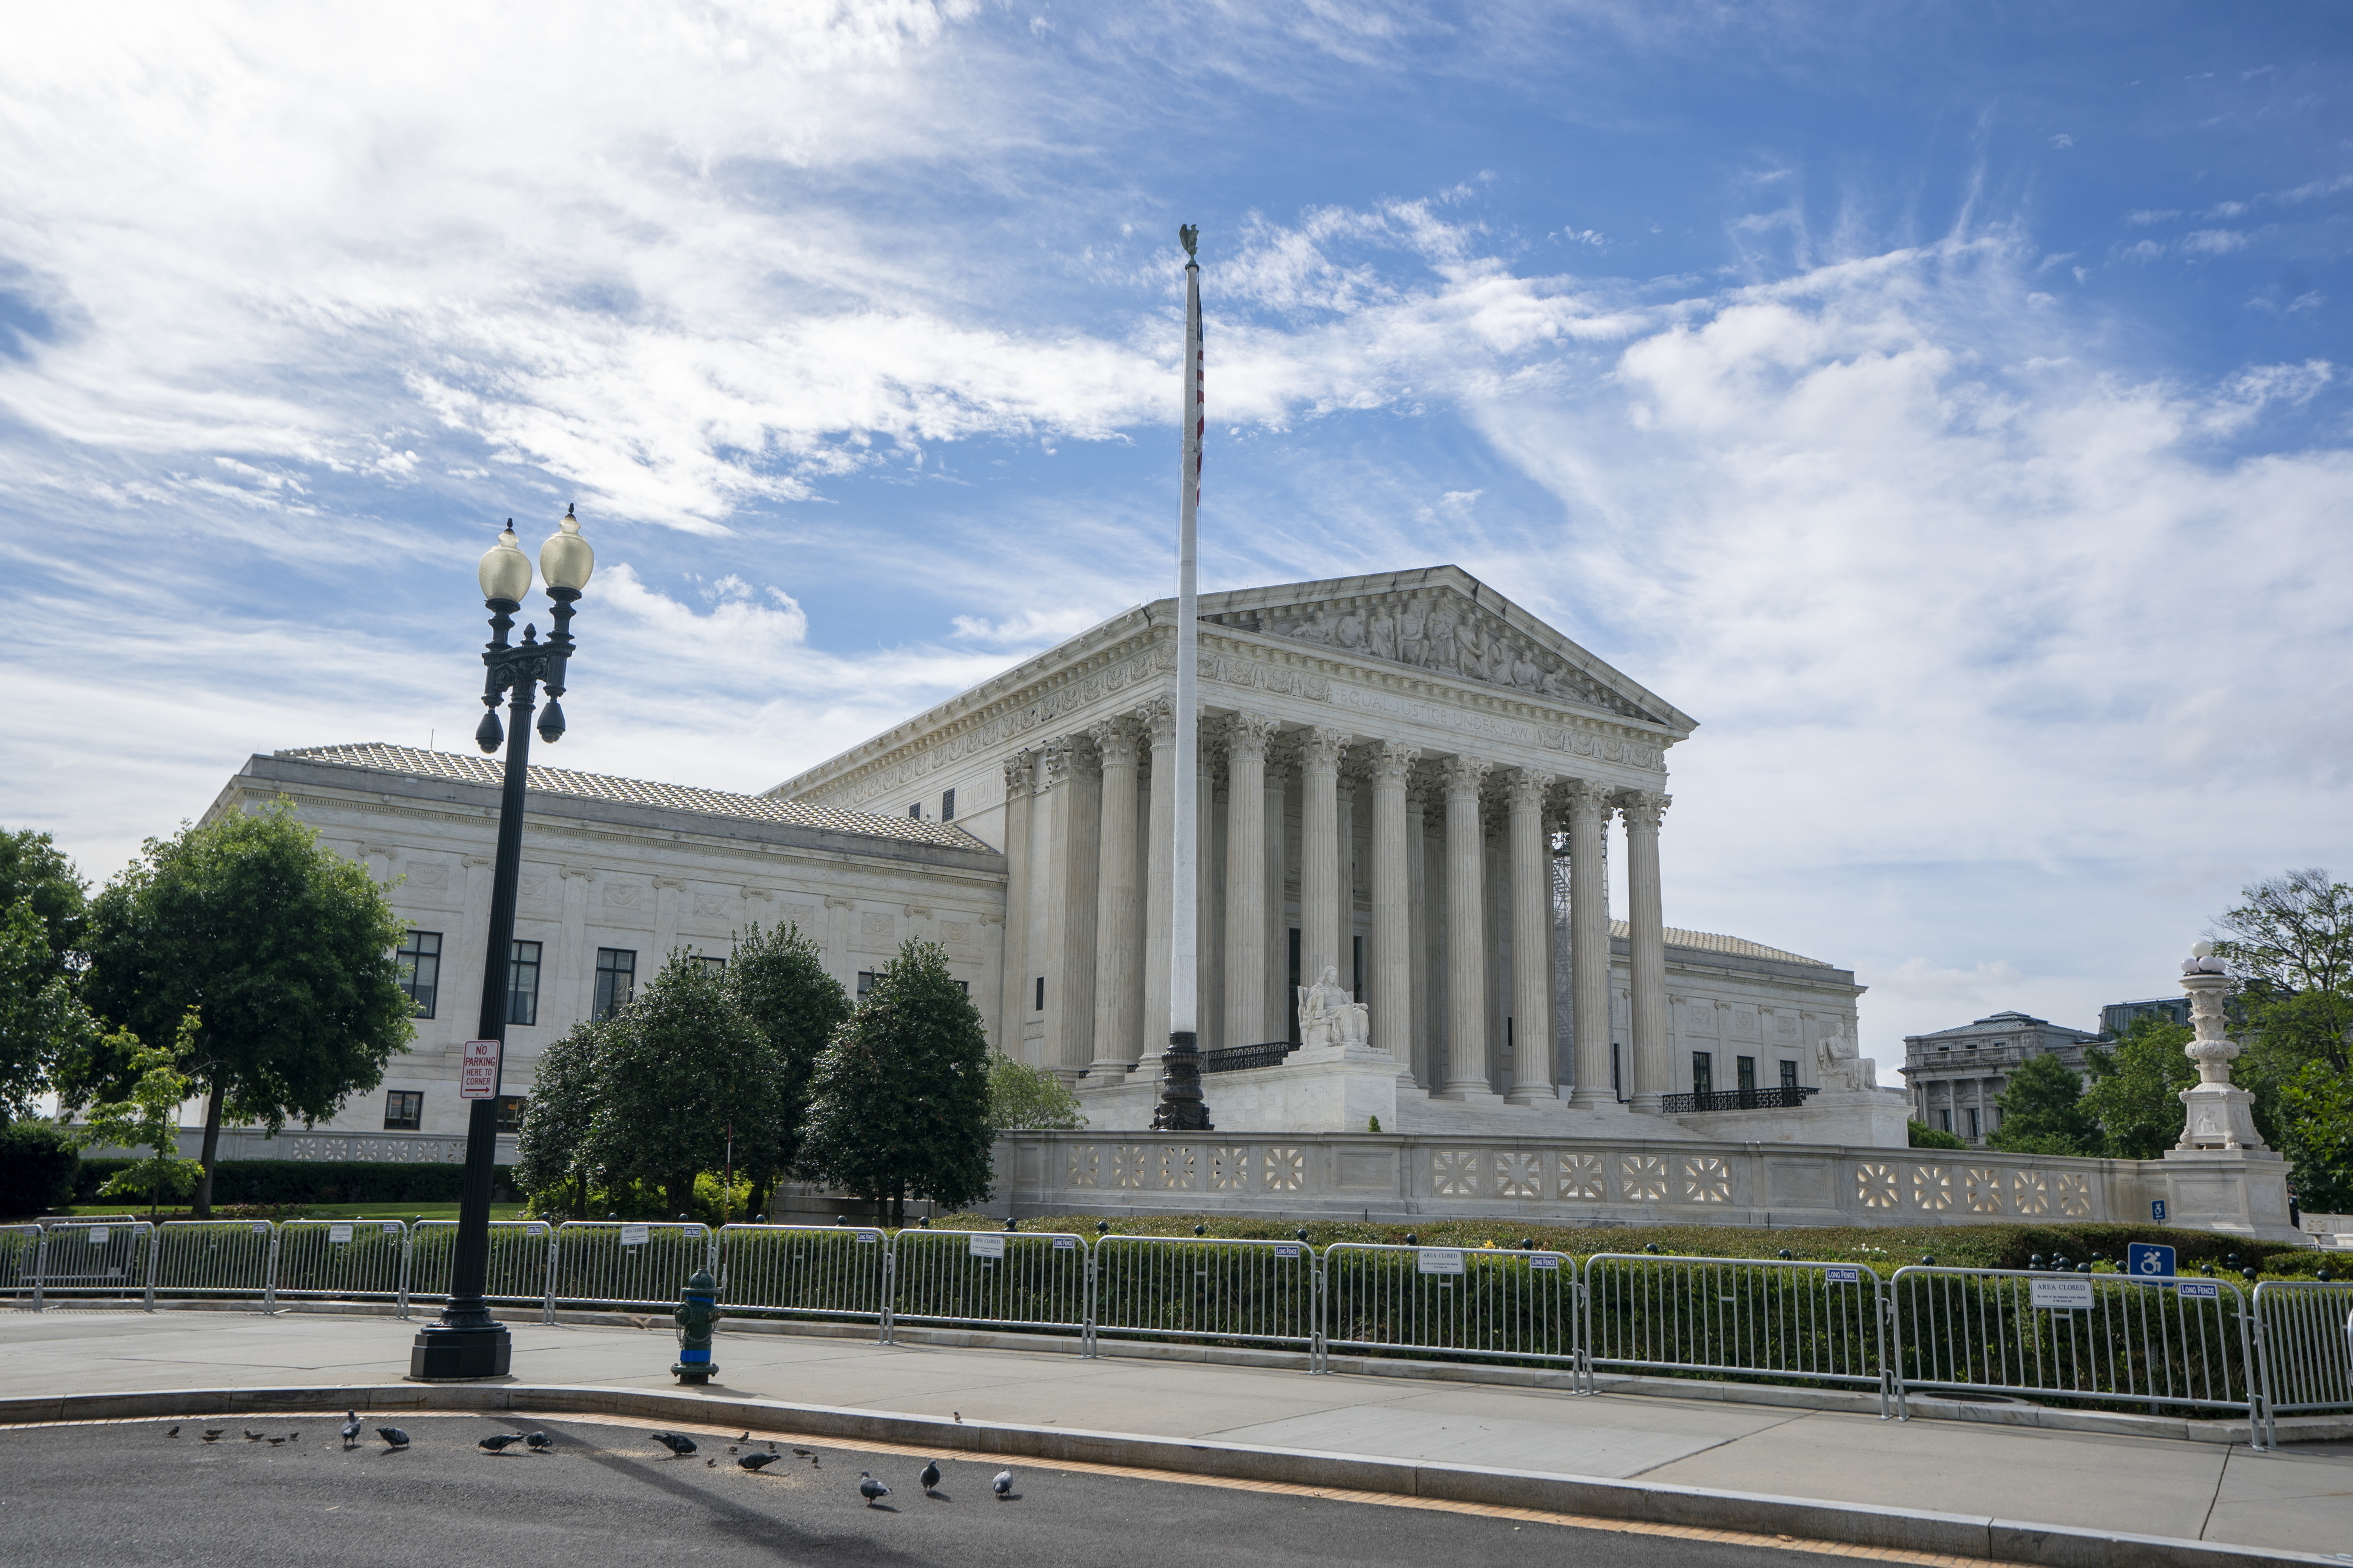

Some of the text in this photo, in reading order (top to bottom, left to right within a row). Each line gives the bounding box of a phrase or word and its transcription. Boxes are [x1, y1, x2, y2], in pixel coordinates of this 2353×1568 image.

[1341, 689, 1528, 739] EQUAL JUSTICE UNDER LAW
[476, 1046, 487, 1055] NO
[465, 1057, 495, 1066] PARKING
[1532, 1257, 1542, 1266] LONG
[1828, 1270, 1855, 1279] LONG FENCE
[2182, 1285, 2215, 1295] LONG FENCE
